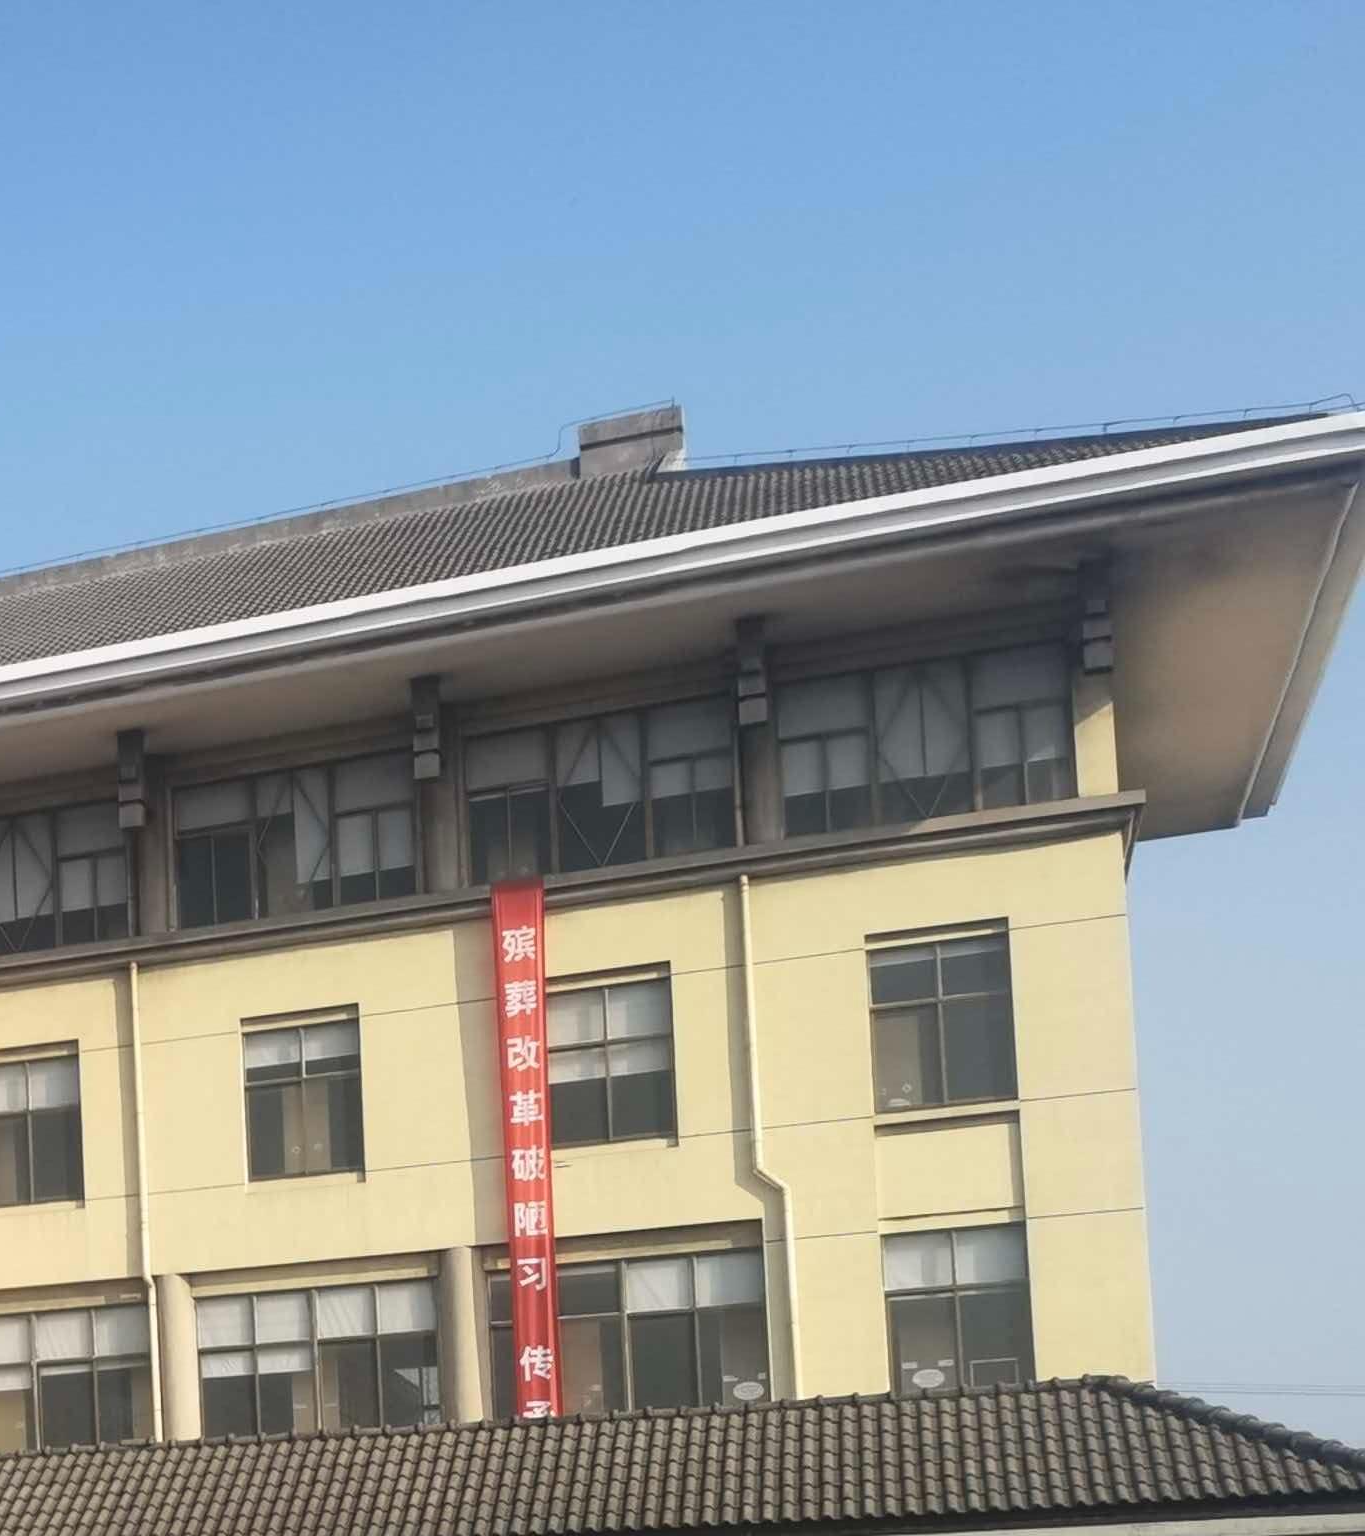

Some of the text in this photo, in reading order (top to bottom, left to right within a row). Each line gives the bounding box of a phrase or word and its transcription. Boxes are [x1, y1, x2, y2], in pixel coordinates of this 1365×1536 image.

[501, 926, 549, 1292] 殡葬改革破陋习
